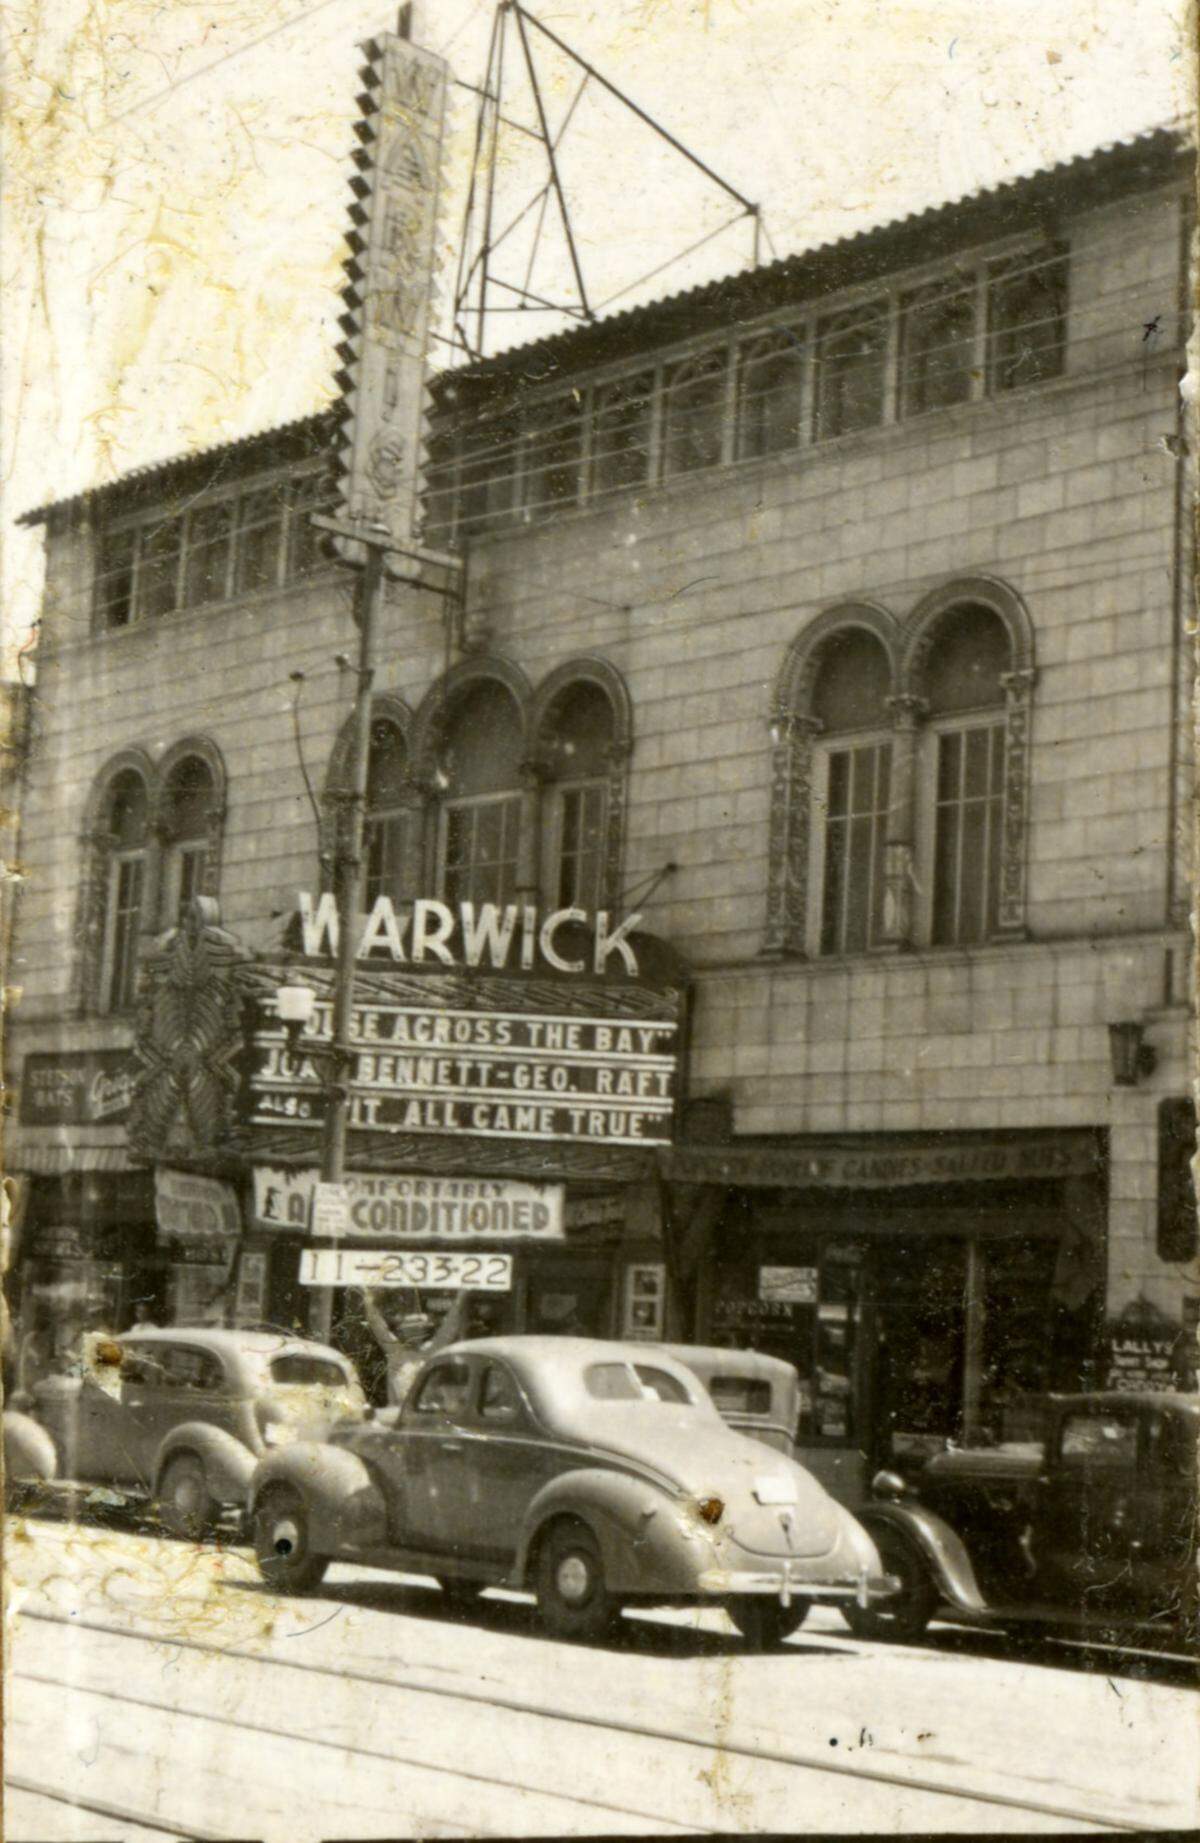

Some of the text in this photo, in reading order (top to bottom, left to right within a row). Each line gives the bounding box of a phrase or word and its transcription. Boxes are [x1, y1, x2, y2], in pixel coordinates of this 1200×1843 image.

[299, 891, 643, 977] WARWICK
[391, 1012, 512, 1046] ACROSS
[527, 1021, 582, 1050] THE
[594, 1027, 673, 1054] BAY"
[596, 1069, 673, 1096] RAFT
[258, 1094, 311, 1118] ALSO
[404, 1101, 459, 1128] ALL
[472, 1105, 554, 1133] CAME
[568, 1110, 662, 1137] TRUE"
[351, 1200, 550, 1233] CONDITIONED
